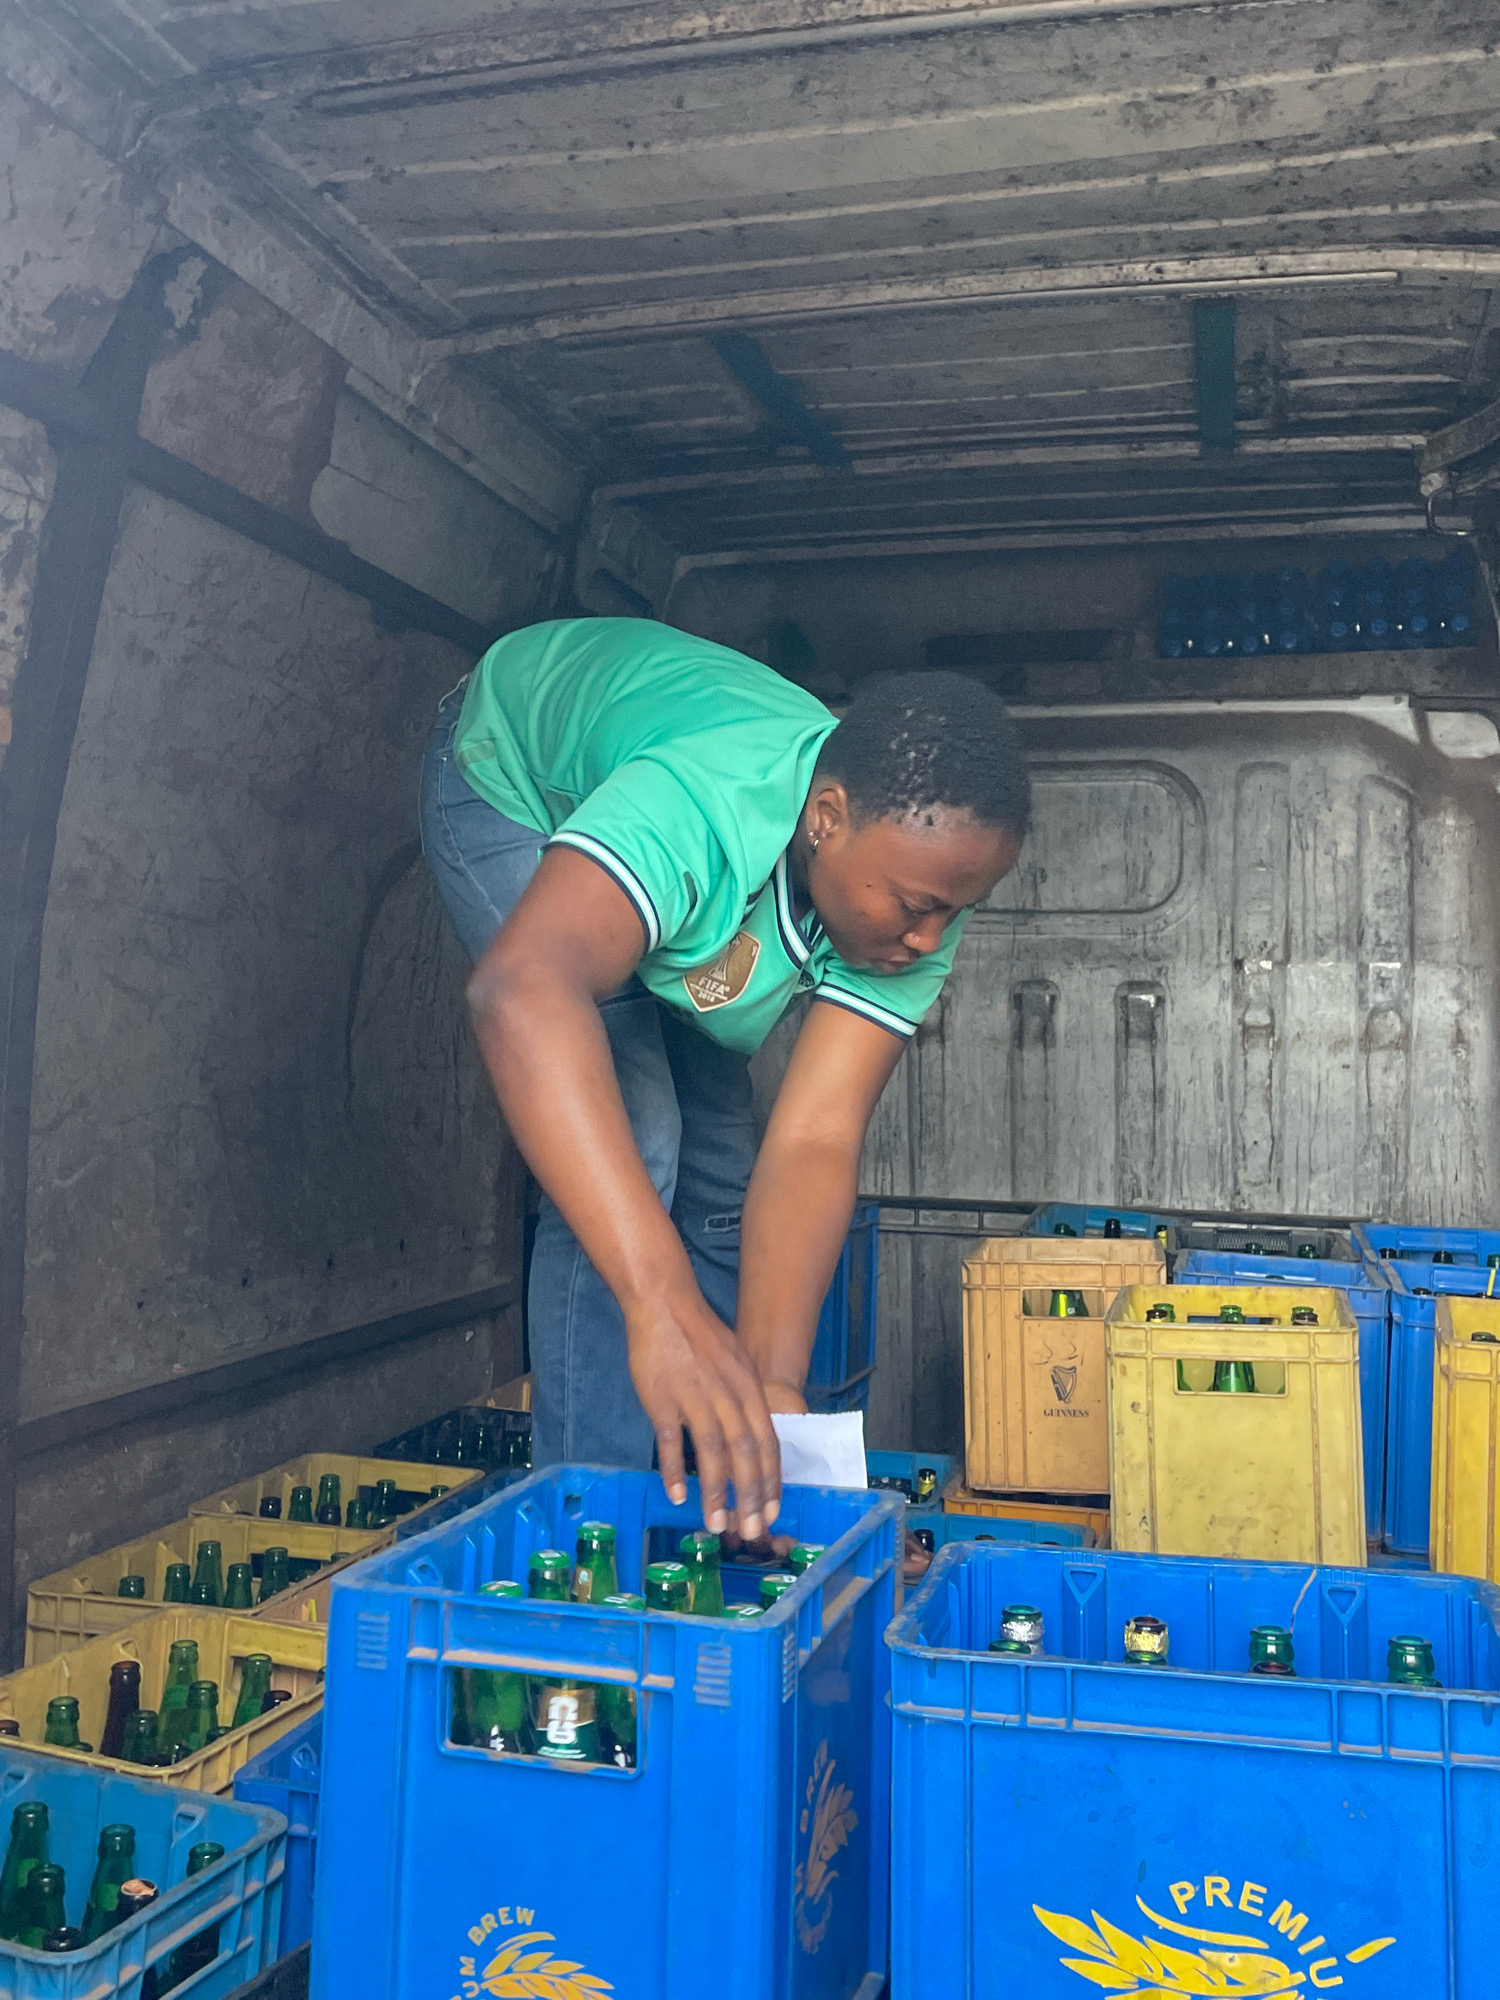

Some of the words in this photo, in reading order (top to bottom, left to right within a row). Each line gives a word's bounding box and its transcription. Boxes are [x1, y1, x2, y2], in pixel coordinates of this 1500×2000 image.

[1043, 1408, 1090, 1418] GUINNESS
[467, 1905, 536, 1947] BREW
[1168, 1875, 1344, 2000] PREMIU
